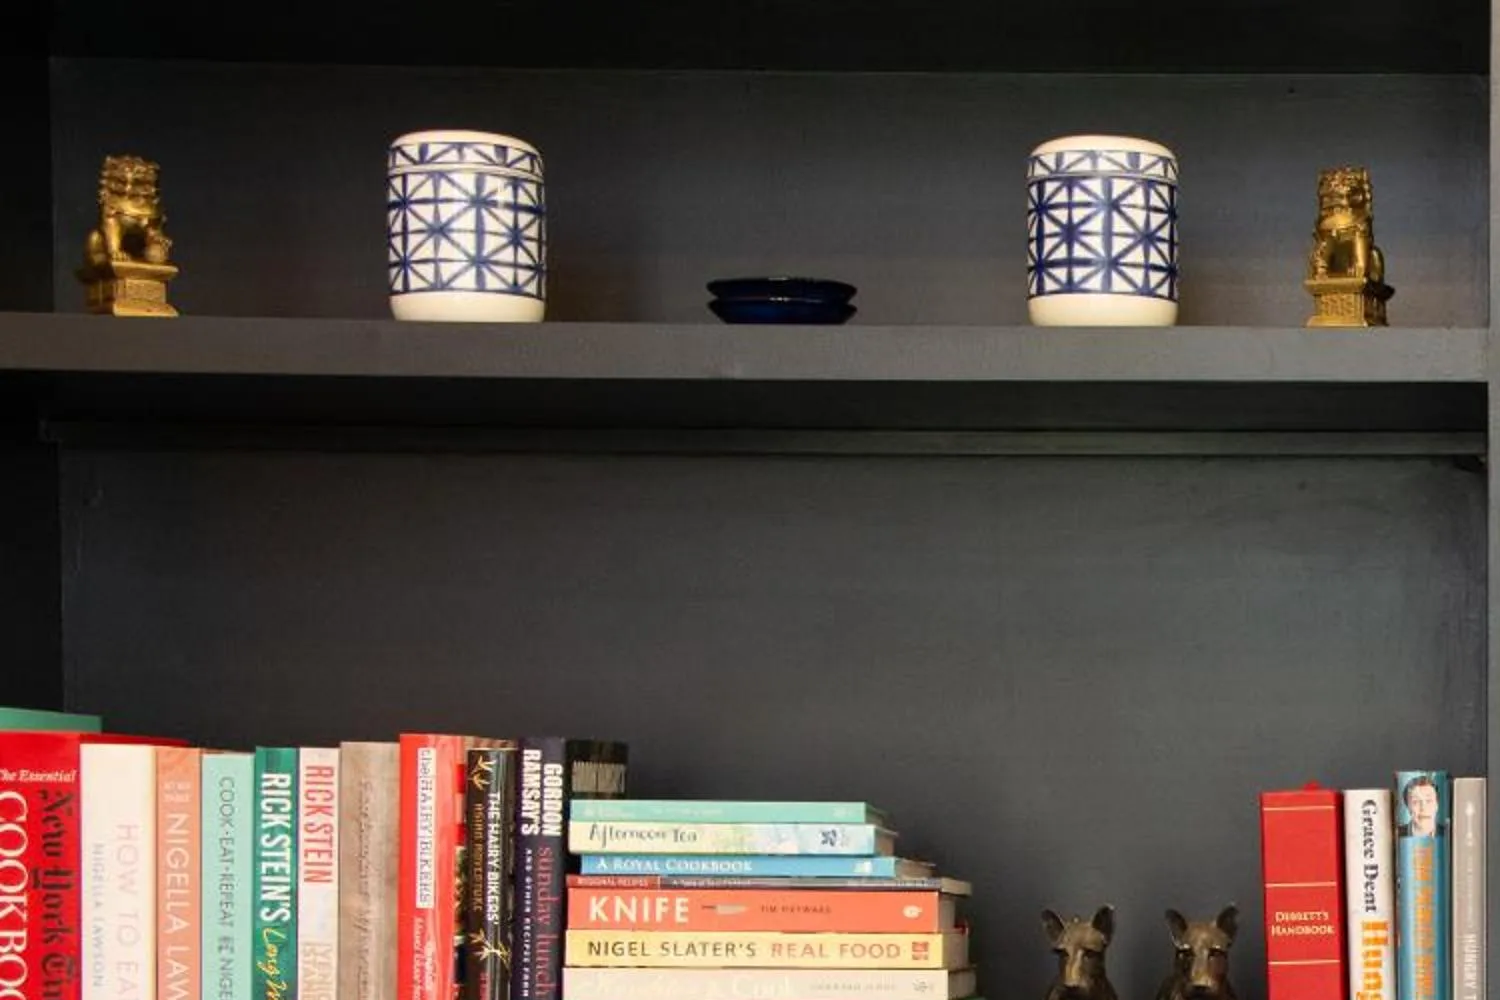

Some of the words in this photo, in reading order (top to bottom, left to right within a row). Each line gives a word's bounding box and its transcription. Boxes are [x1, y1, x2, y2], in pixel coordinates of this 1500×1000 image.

[260, 773, 291, 828] RICK
[304, 766, 334, 816] RICK
[520, 750, 541, 836] RAMSAY'S
[543, 764, 563, 836] GORDON
[304, 822, 334, 884] STEIN
[589, 826, 667, 847] Afternoon
[673, 826, 697, 842] Tea
[1362, 800, 1378, 859] Grace
[166, 813, 190, 933] NIGELLA
[260, 834, 291, 922] STEIN'S
[522, 849, 531, 872] AND
[536, 847, 557, 925] sunday
[598, 859, 607, 872] A
[613, 860, 662, 873] ROYAL
[666, 860, 752, 872] COOKBOOK
[1365, 864, 1378, 912] Dent
[522, 876, 531, 912] OTHER
[590, 897, 688, 923] KNIFE
[522, 918, 531, 962] RECIPES
[536, 934, 557, 996] lunch
[588, 941, 651, 956] NIGEL
[661, 941, 756, 957] SLATER'S
[772, 944, 828, 958] REAL
[839, 944, 901, 959] FOOD
[1464, 933, 1481, 990] HUNGRY
